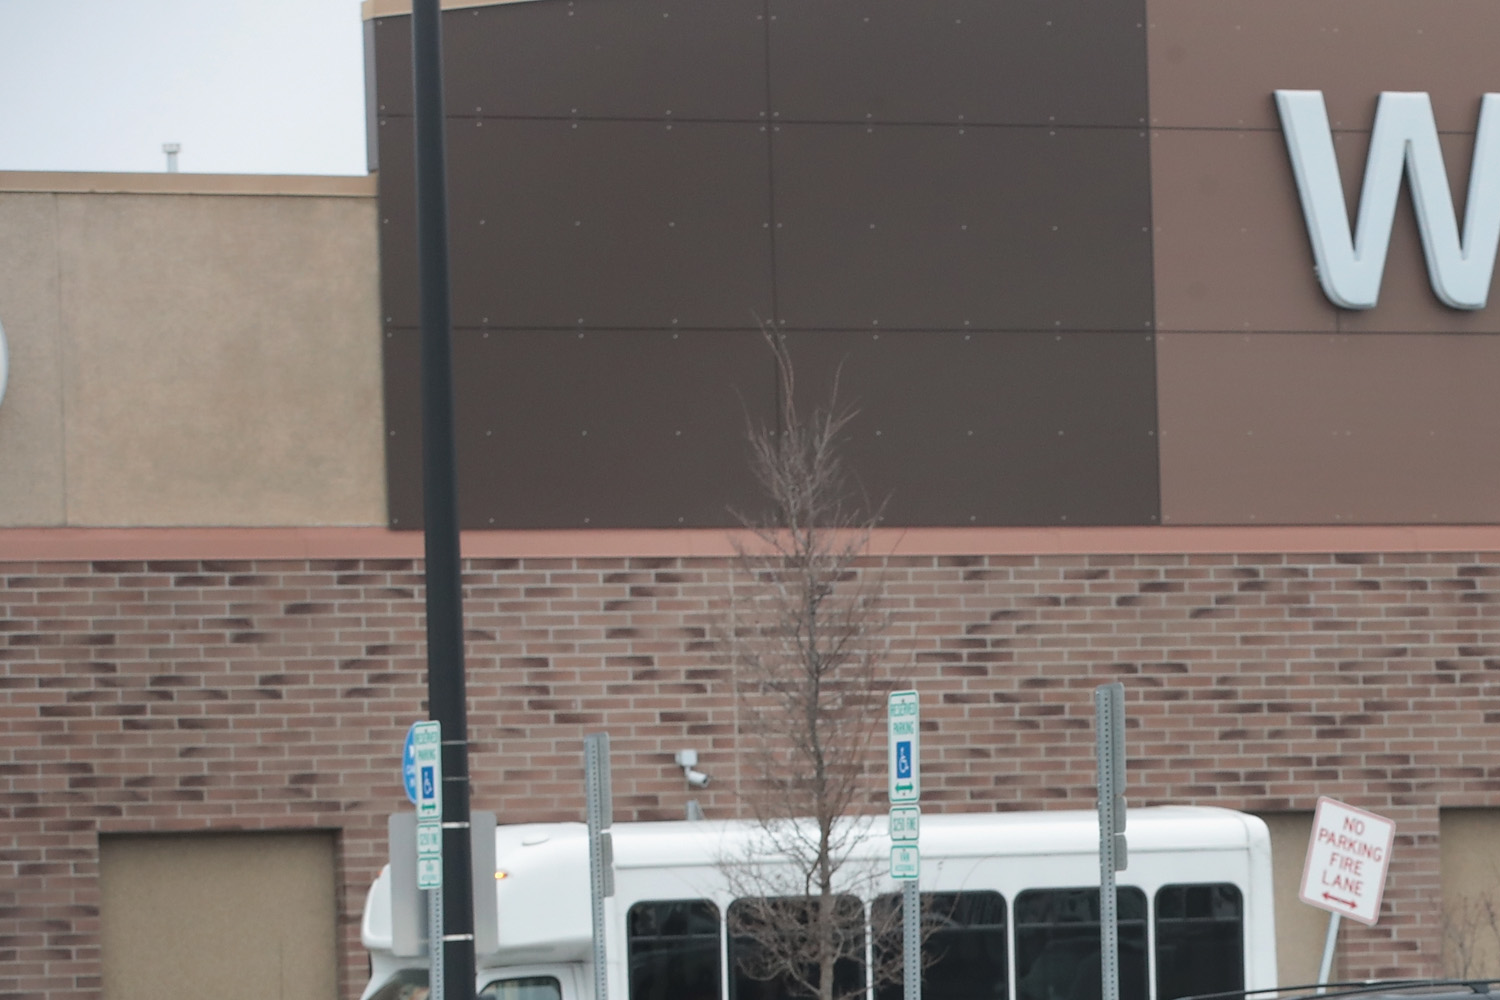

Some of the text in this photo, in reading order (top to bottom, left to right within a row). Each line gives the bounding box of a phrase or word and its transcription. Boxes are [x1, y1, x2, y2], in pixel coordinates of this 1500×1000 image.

[1343, 816, 1366, 836] NO
[1318, 828, 1384, 862] PARKING
[1329, 852, 1364, 877] FIRE
[1321, 870, 1364, 897] LANE
